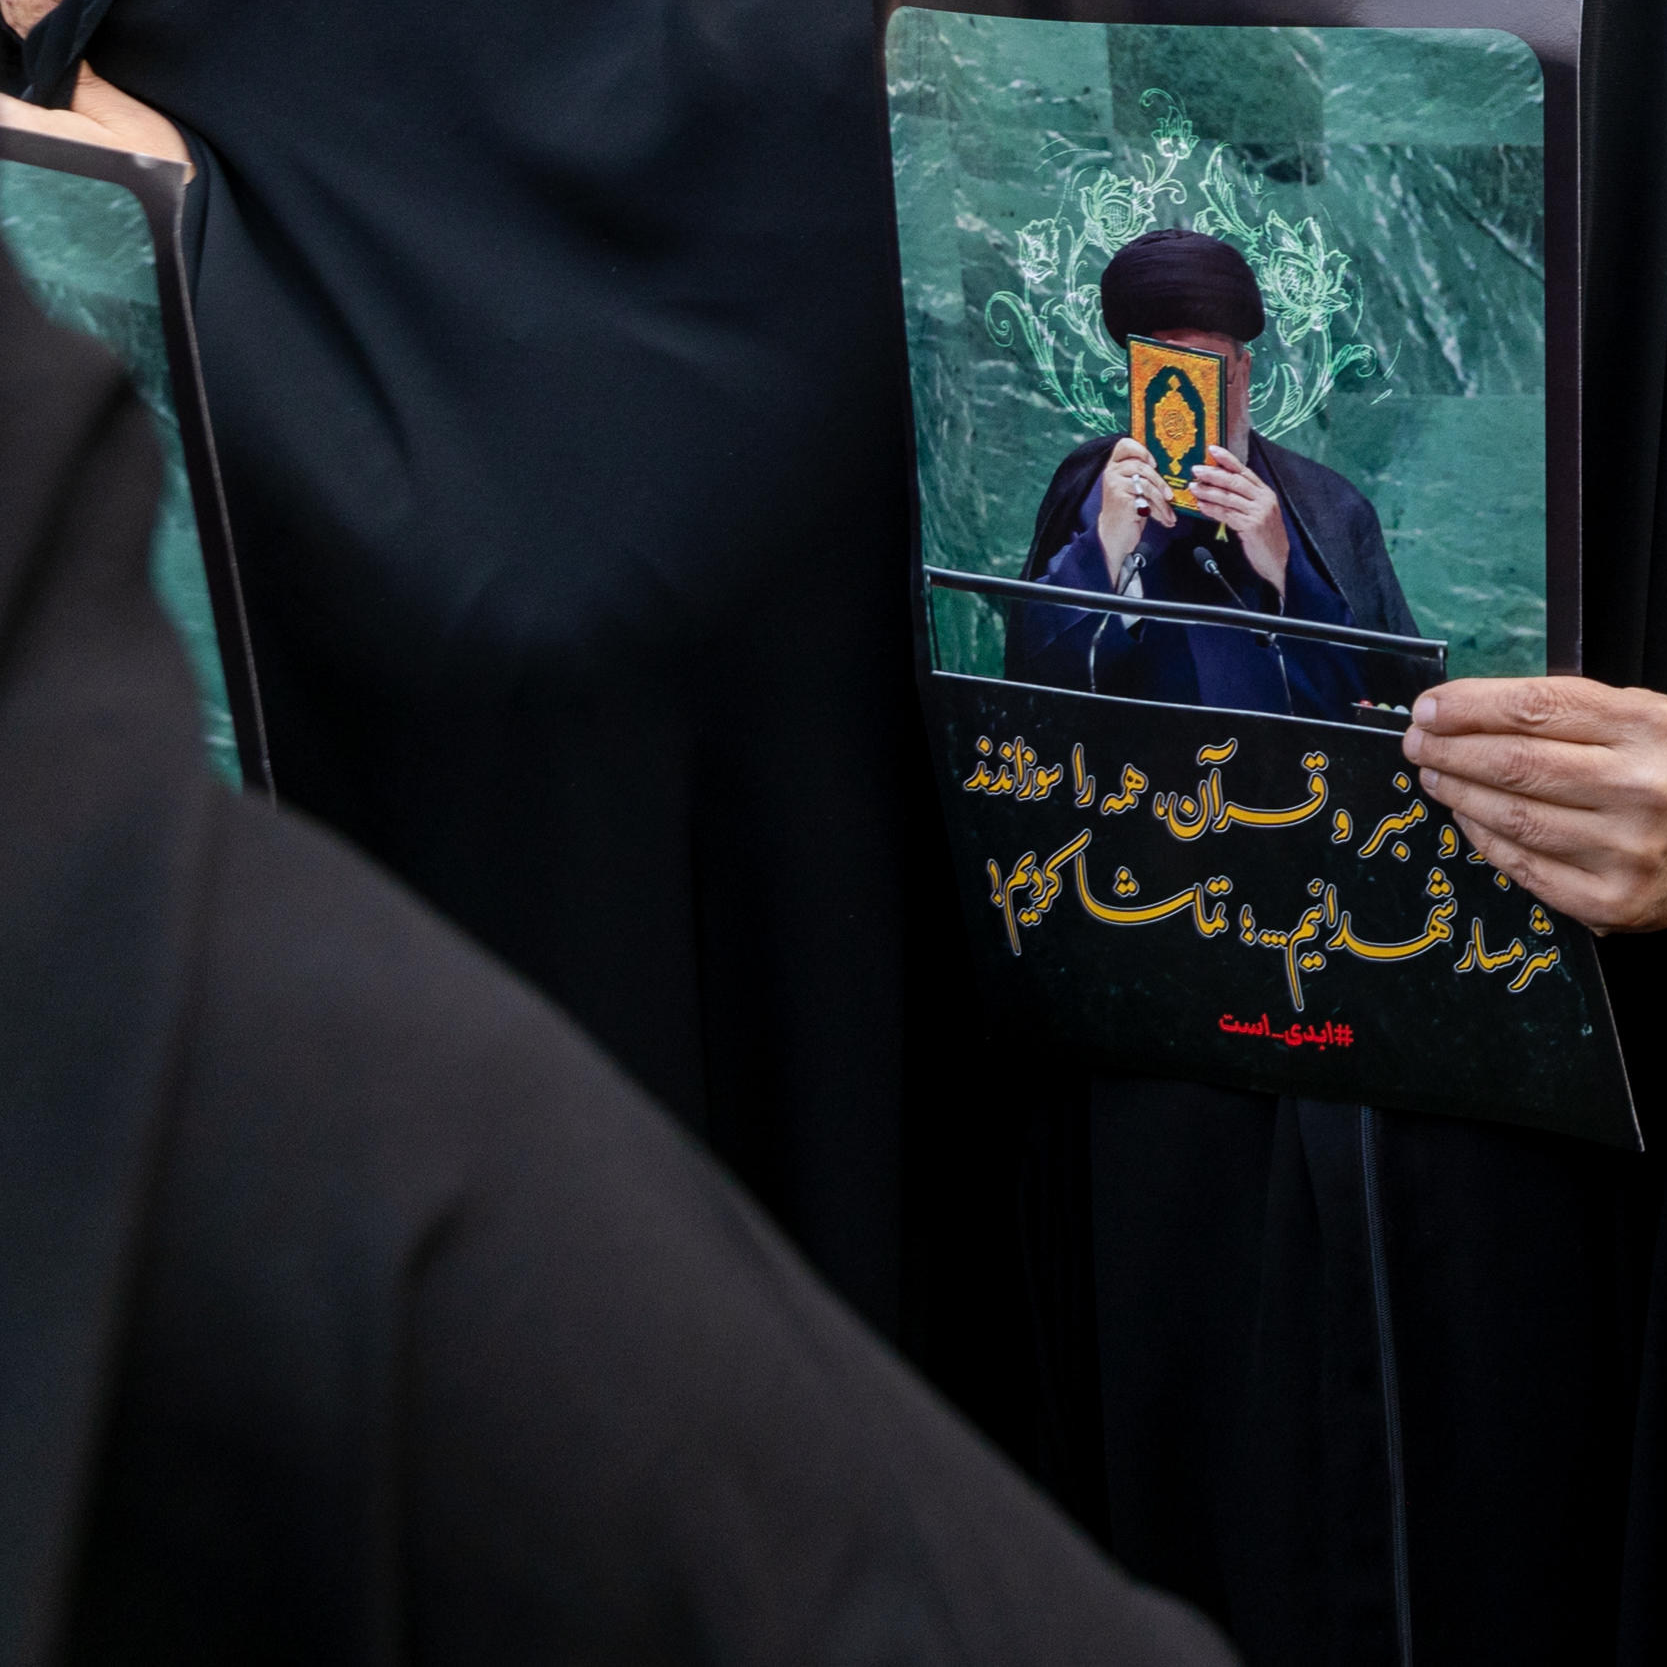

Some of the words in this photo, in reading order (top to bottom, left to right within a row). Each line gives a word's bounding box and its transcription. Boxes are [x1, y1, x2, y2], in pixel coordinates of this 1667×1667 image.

[964, 735, 1063, 802] سوزاندند
[1072, 742, 1096, 808] را
[1100, 763, 1148, 815] همه
[1331, 808, 1353, 844] و
[1358, 771, 1428, 862] منبر
[1438, 824, 1459, 859] و
[1075, 850, 1233, 938] تماشا
[1454, 904, 1561, 993] شرمسار
[1218, 1013, 1354, 1052] #ابدی_است
